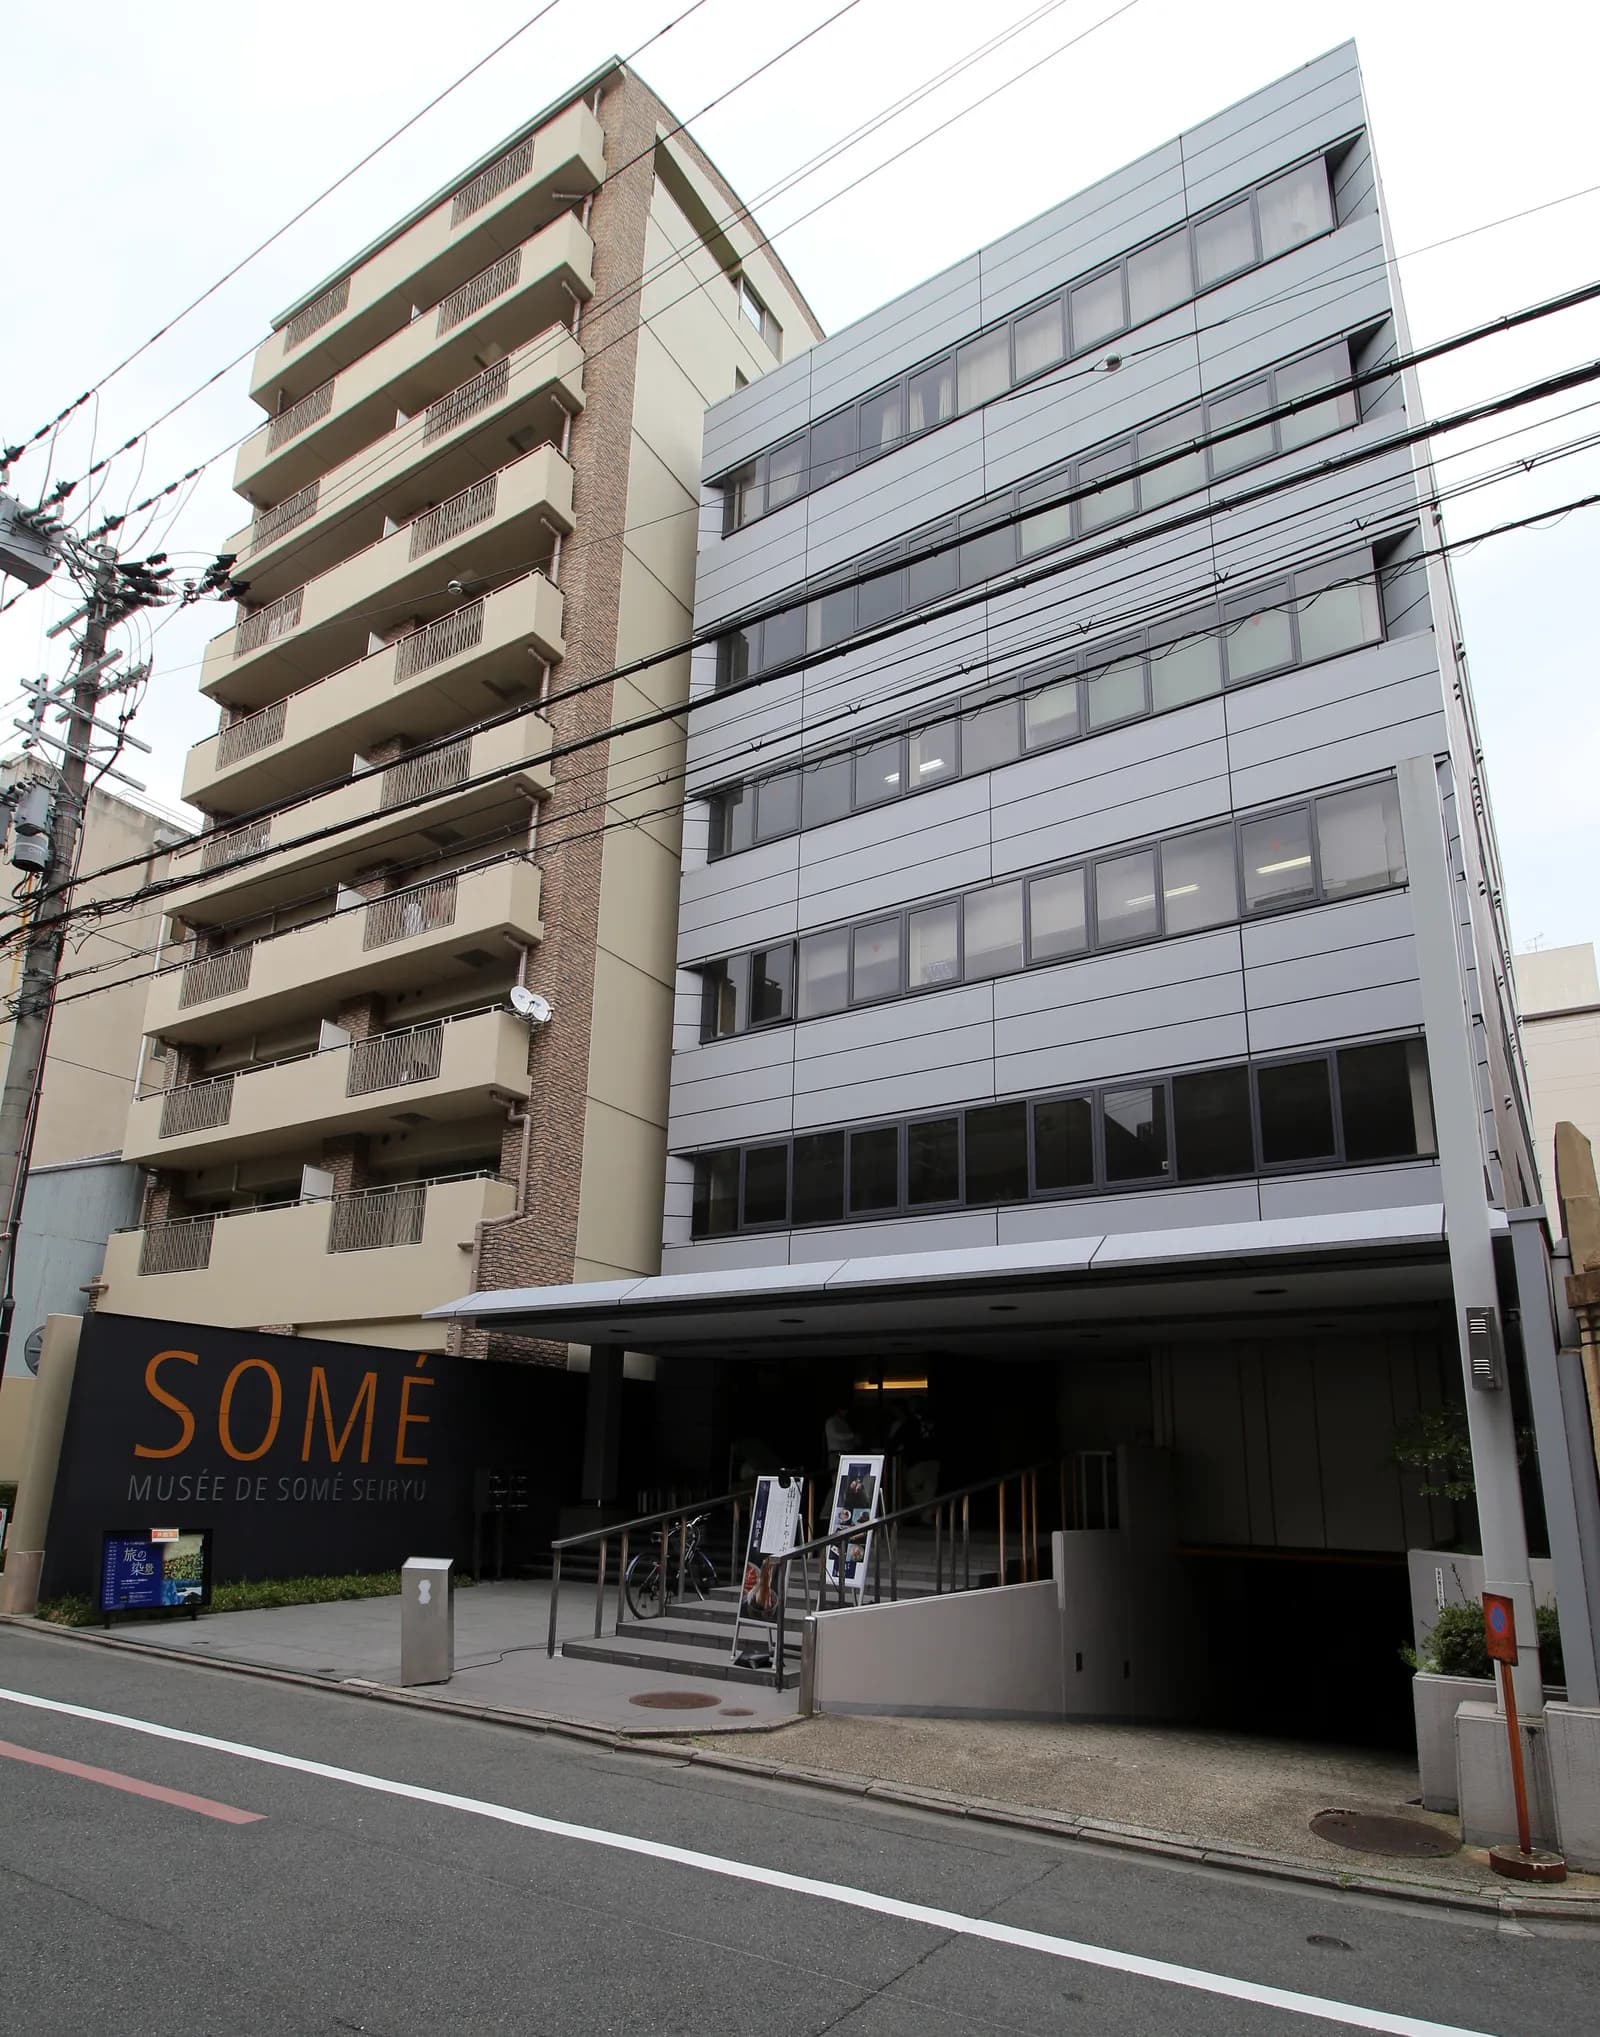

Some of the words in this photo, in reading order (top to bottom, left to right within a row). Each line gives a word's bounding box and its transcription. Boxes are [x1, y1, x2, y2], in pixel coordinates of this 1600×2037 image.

[133, 1350, 435, 1465] SOMÉ
[127, 1469, 227, 1501] MUSÉE
[235, 1477, 269, 1501] DE
[276, 1471, 345, 1501] SOMÉ
[352, 1478, 427, 1502] SEIRYU
[123, 1547, 147, 1562] 旅の
